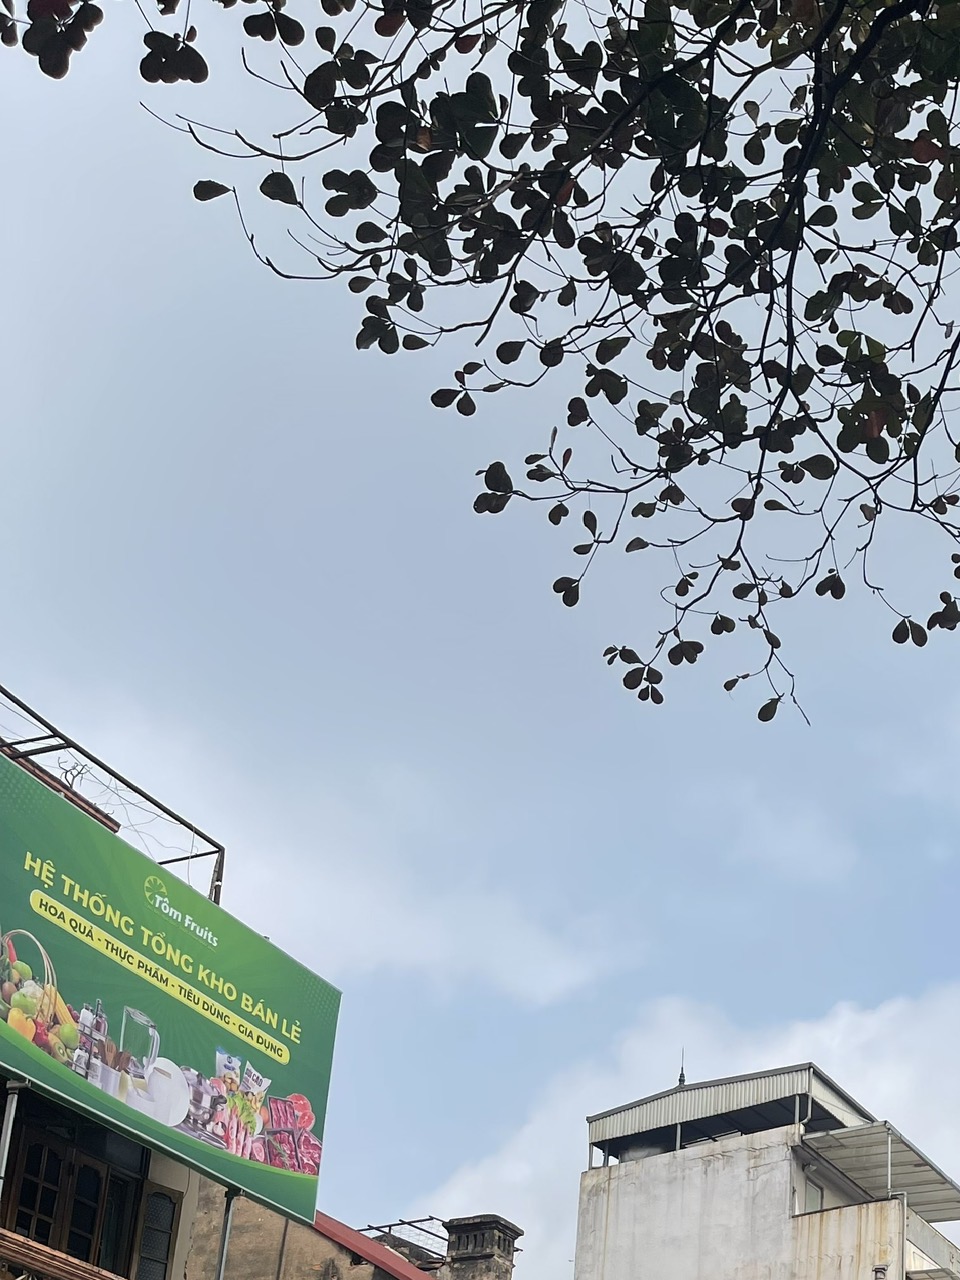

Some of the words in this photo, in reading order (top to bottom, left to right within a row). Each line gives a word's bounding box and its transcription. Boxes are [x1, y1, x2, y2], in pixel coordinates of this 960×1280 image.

[24, 852, 56, 888] HỆ
[61, 874, 134, 936] THỐNG
[140, 926, 193, 973] TỔNG
[198, 964, 237, 1001] KHO
[240, 992, 278, 1029] BÁN
[281, 1018, 302, 1044] LẺ
[39, 898, 66, 923] HOA
[69, 918, 94, 941] QUẢ
[105, 938, 134, 963] THỰC
[137, 959, 169, 987] PHẨM
[177, 984, 200, 1006] TIÊU
[202, 1002, 231, 1025] DÙNG
[238, 1023, 254, 1040] GIA
[256, 1035, 283, 1058] DỤNG
[155, 894, 182, 922] Tôm
[184, 914, 219, 947] Fruits
